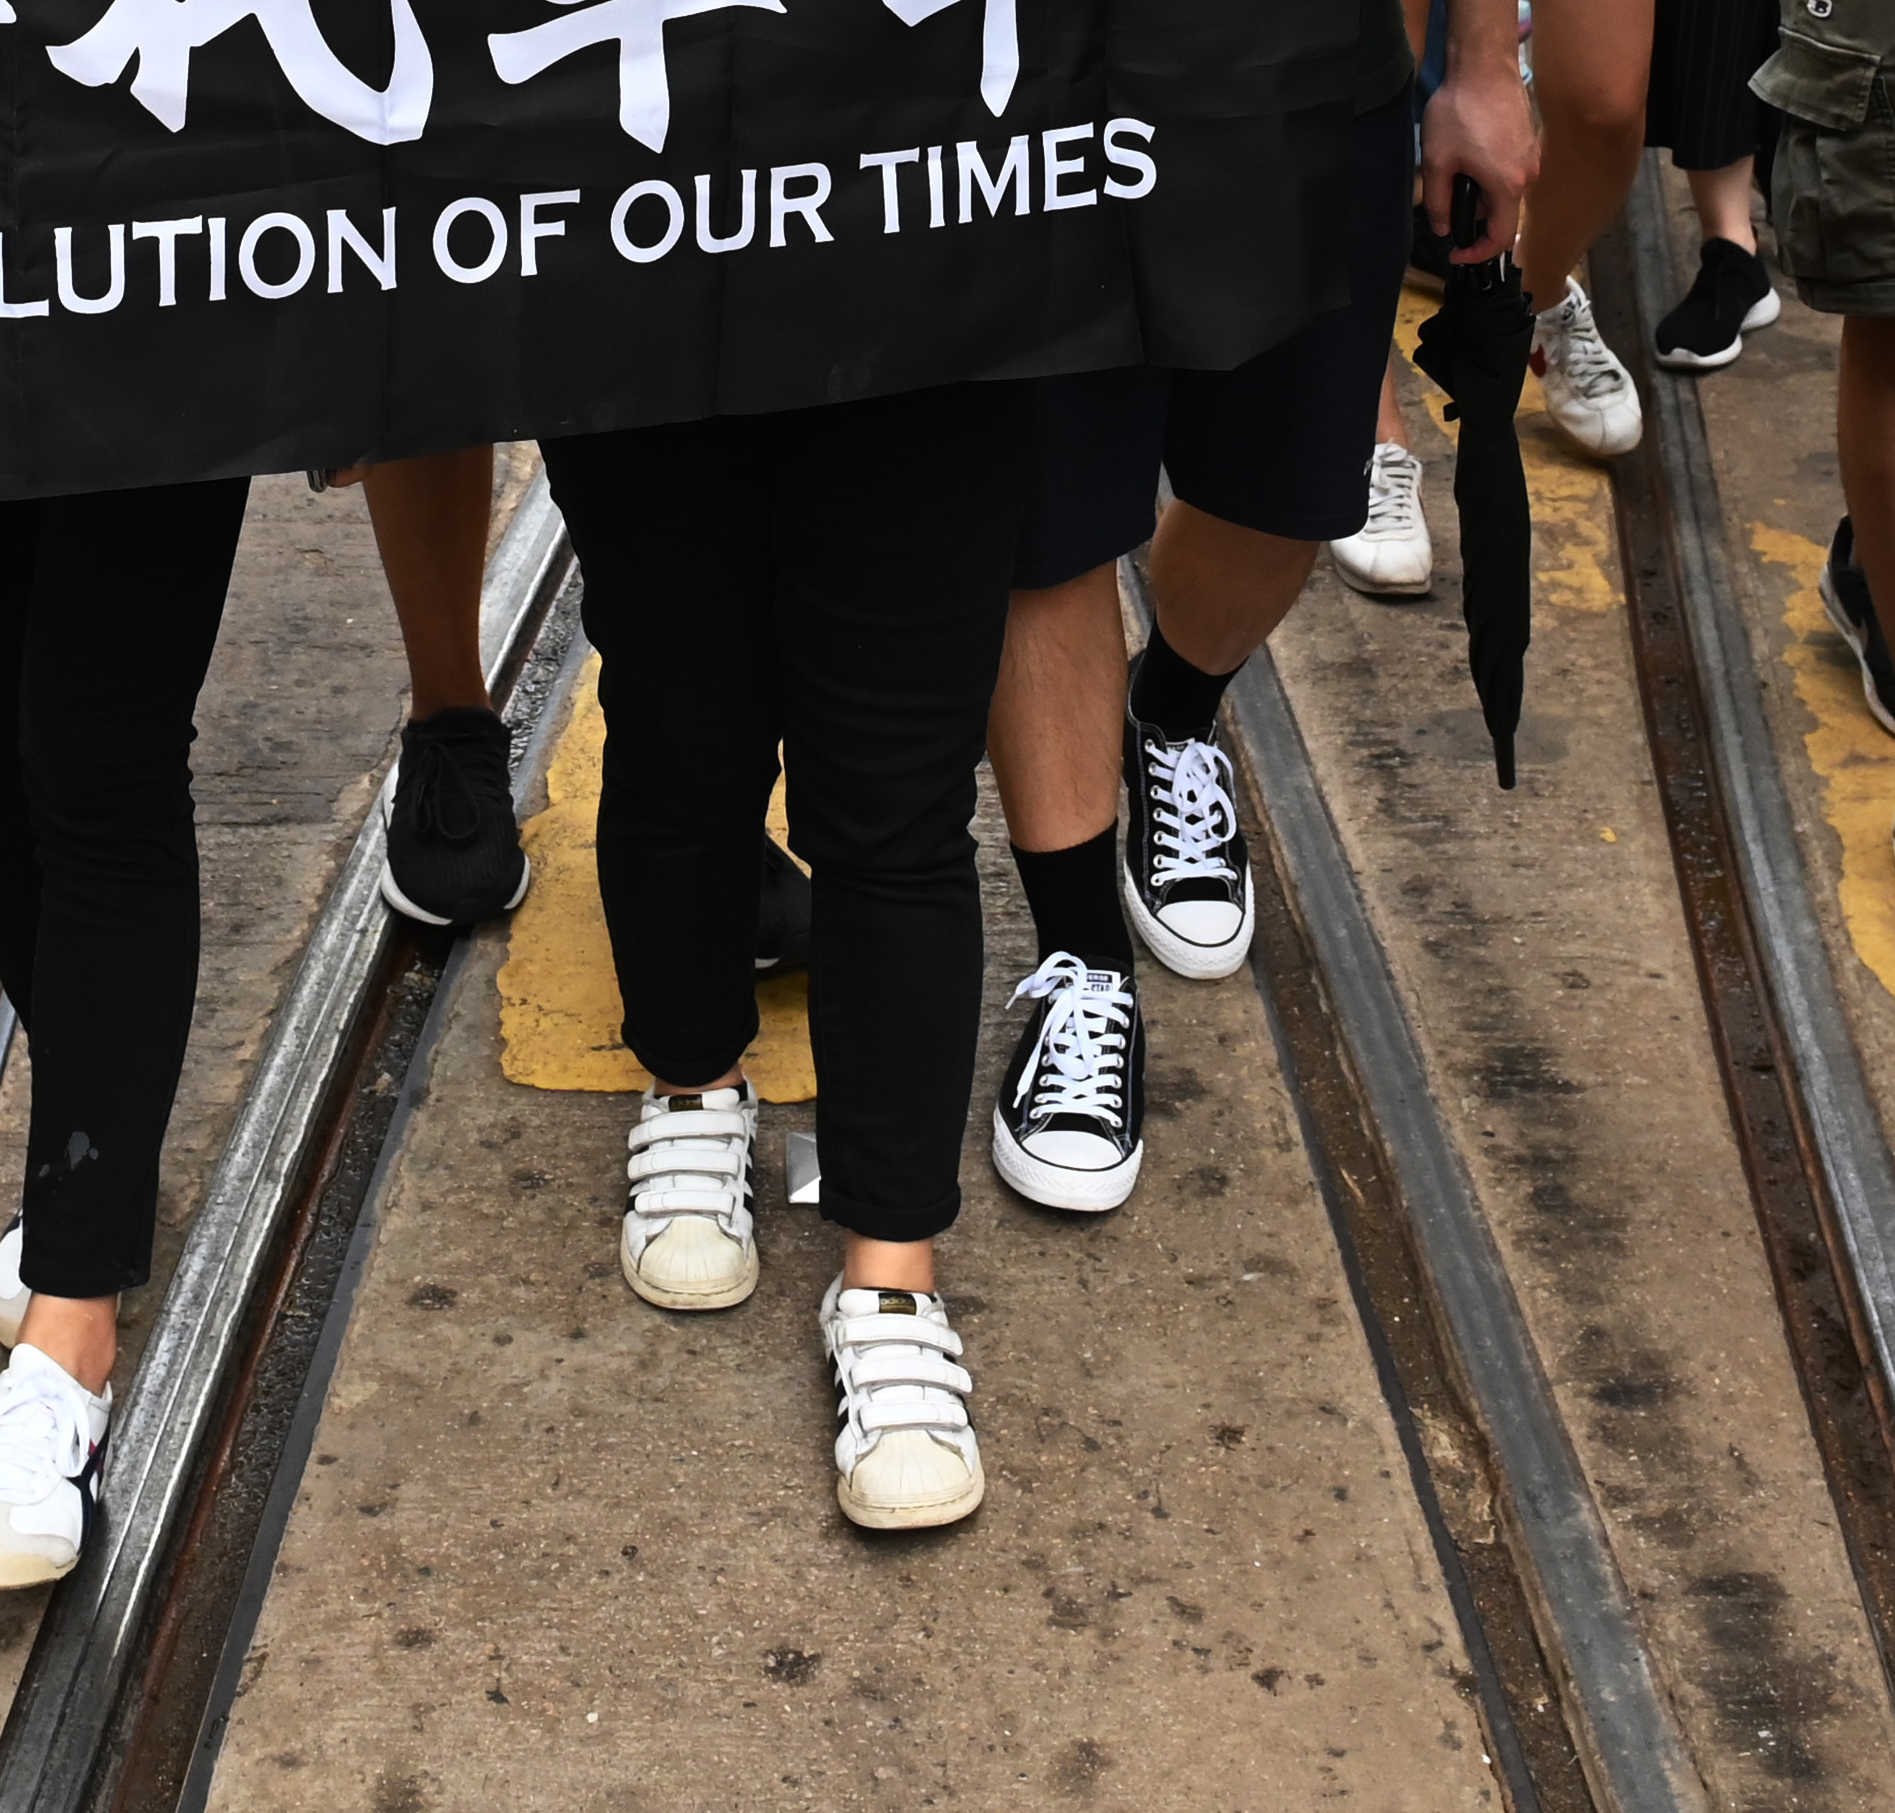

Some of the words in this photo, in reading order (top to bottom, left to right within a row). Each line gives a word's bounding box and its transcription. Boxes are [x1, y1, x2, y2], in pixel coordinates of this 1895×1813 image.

[431, 187, 583, 286] OF
[608, 160, 837, 264] OUR
[857, 115, 1159, 236] TIMES
